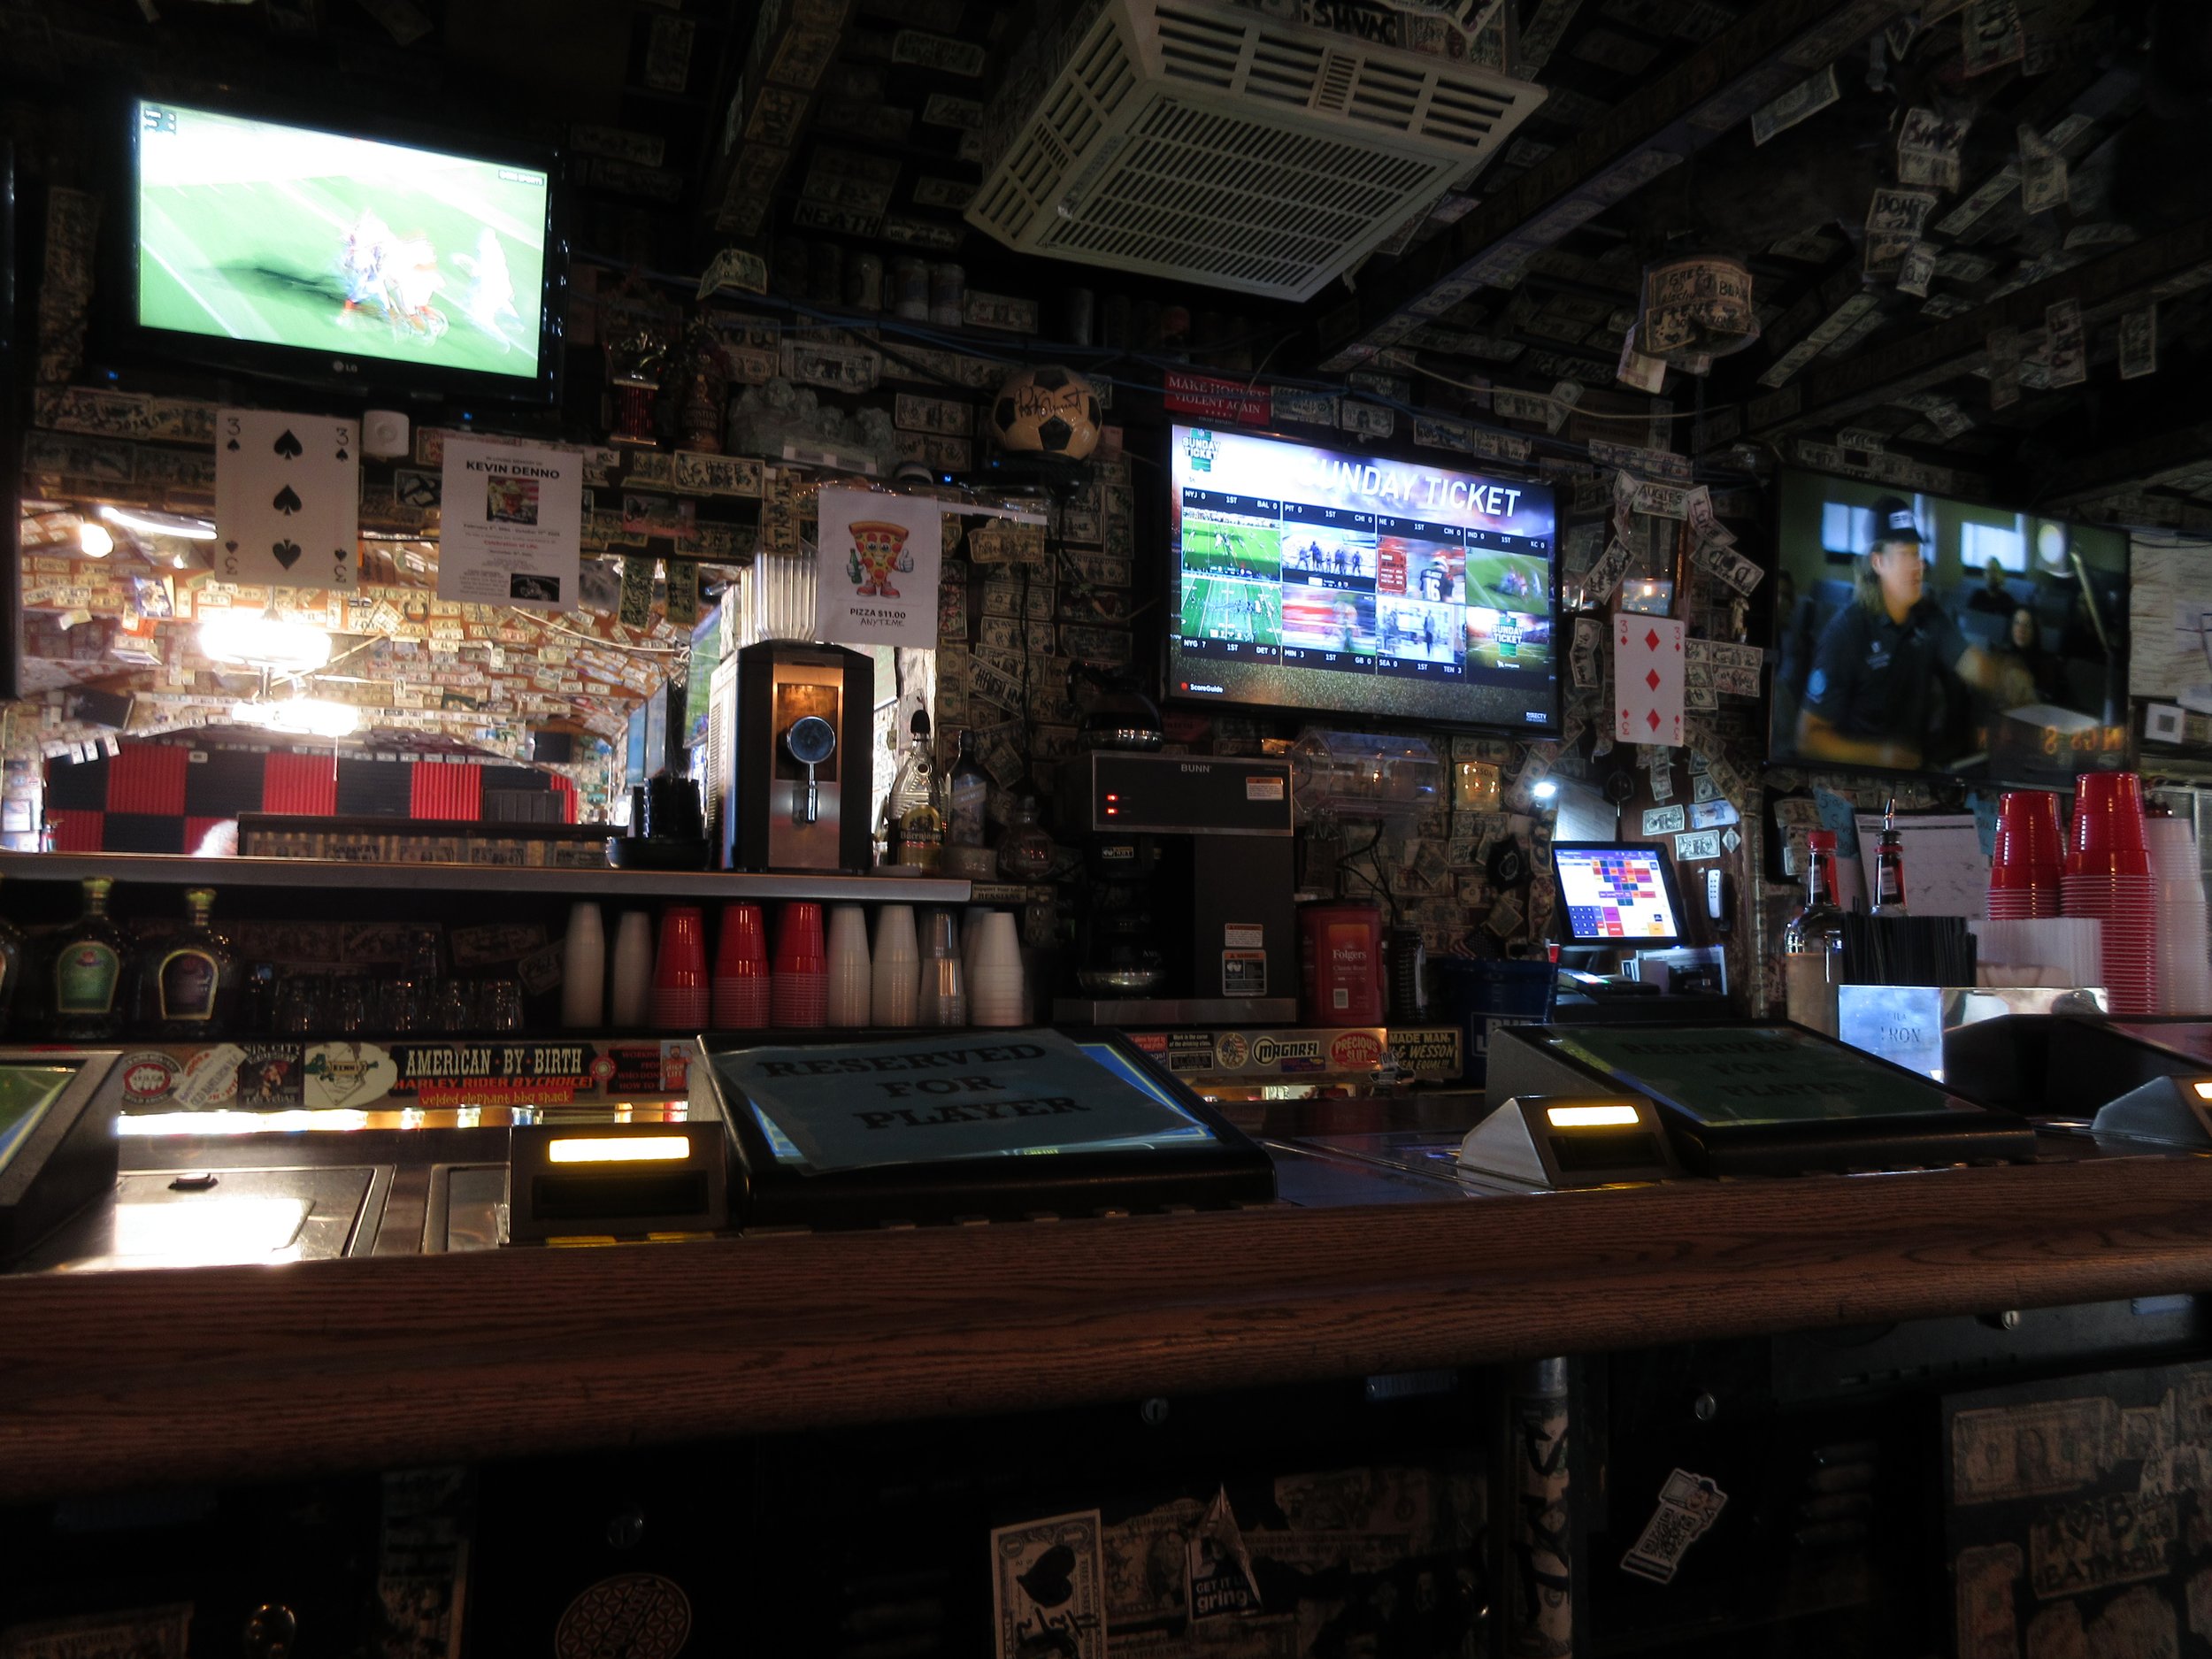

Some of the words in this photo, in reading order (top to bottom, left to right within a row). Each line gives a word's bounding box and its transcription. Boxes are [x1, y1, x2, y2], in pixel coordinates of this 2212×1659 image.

[1169, 376, 1209, 394] MAKE
[1174, 392, 1225, 409] VIOLENT
[1226, 400, 1260, 414] AGAIN
[227, 417, 241, 436] 3
[335, 426, 348, 446] 3
[1182, 437, 1221, 452] SUNDAY
[1185, 447, 1218, 460] TICKET
[466, 460, 507, 473] KEVIN
[512, 465, 560, 480] DENNO
[1185, 489, 1198, 499] NYJ
[1225, 495, 1237, 504] 1ST
[1256, 500, 1270, 509] BAL
[1425, 475, 1521, 518] TICKET
[1285, 503, 1294, 512] PIT
[1325, 510, 1337, 518] 1ST
[1530, 540, 1539, 549] KC
[849, 608, 876, 618] PIZZA
[878, 610, 906, 619] $11.00
[1492, 624, 1524, 636] SUNDAY
[1620, 619, 1628, 634] 3
[1494, 633, 1522, 645] TICKET
[1183, 639, 1198, 649] NYG
[1226, 643, 1238, 652] 1ST
[1256, 646, 1269, 655] DET
[1285, 649, 1297, 657] MIN
[1325, 653, 1337, 662] 1ST
[1379, 658, 1390, 667] SEA
[1190, 683, 1224, 694] ScoreGuide
[1180, 764, 1210, 773] BUNN
[1333, 949, 1367, 962] Folgers
[1334, 1036, 1379, 1053] PRECIOUS
[1388, 1033, 1420, 1044] MADE
[1346, 1049, 1368, 1061] SLUT
[1409, 1044, 1455, 1059] WESSON
[1618, 1041, 1795, 1055] RESERVED
[405, 1048, 491, 1076] AMERICAN
[503, 1048, 525, 1075] BY
[534, 1048, 582, 1075] BIRTH
[757, 1043, 1047, 1077] RESERVED
[1711, 1063, 1786, 1076] FOR
[395, 1078, 458, 1090] HARLEY
[462, 1077, 510, 1088] RIDER
[512, 1077, 535, 1087] BY
[536, 1076, 594, 1088] CHOICE!
[876, 1075, 1007, 1098] FOR
[420, 1093, 459, 1106] welded
[461, 1092, 511, 1105] elephant
[513, 1092, 535, 1104] bbq
[538, 1090, 571, 1103] shack
[852, 1097, 1092, 1130] PLAYER
[1195, 1579, 1217, 1594] GET
[1220, 1578, 1231, 1589] IT
